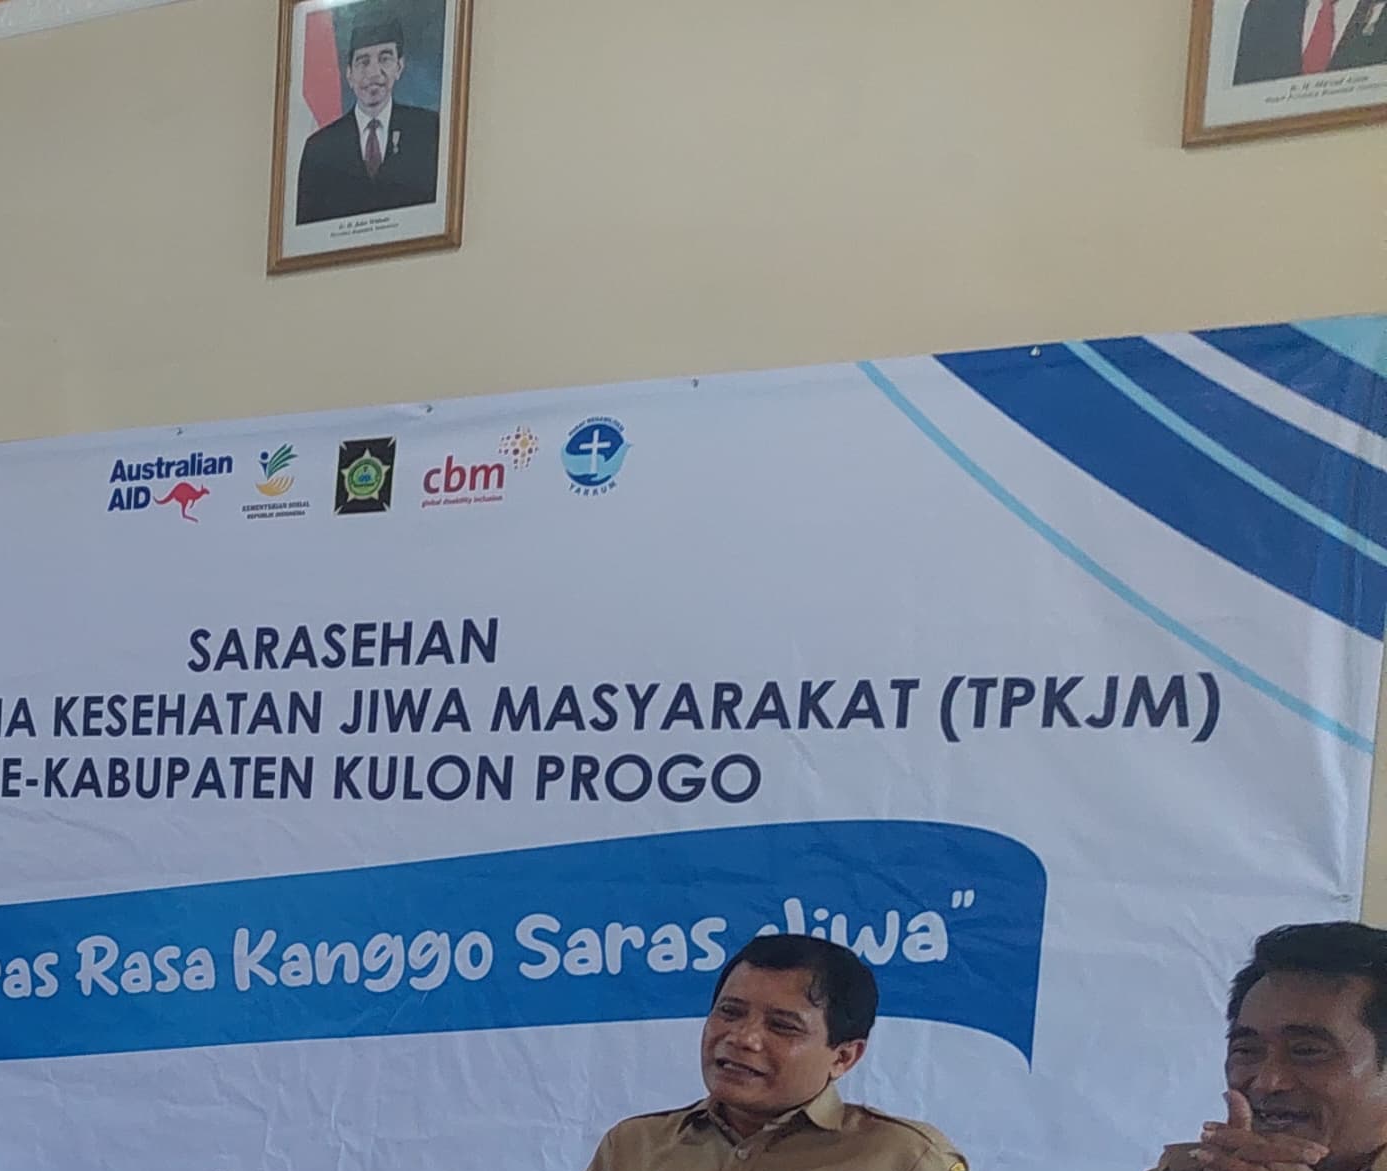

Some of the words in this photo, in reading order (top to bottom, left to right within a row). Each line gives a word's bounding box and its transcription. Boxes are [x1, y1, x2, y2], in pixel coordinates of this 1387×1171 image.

[109, 452, 233, 483] Australian
[423, 455, 505, 494] cbm
[107, 486, 151, 512] AID
[187, 617, 499, 673] SARASEHAN
[53, 689, 323, 738] KESEHATAN
[339, 686, 472, 734] JIWA
[490, 679, 921, 732] MASYARAKAT
[940, 672, 1221, 743] (TPKJM)
[333, 754, 514, 801] KULON
[535, 753, 762, 803] PROGO
[76, 935, 216, 996] Rasa
[233, 926, 494, 993] Kanggo
[514, 913, 728, 981] Saras
